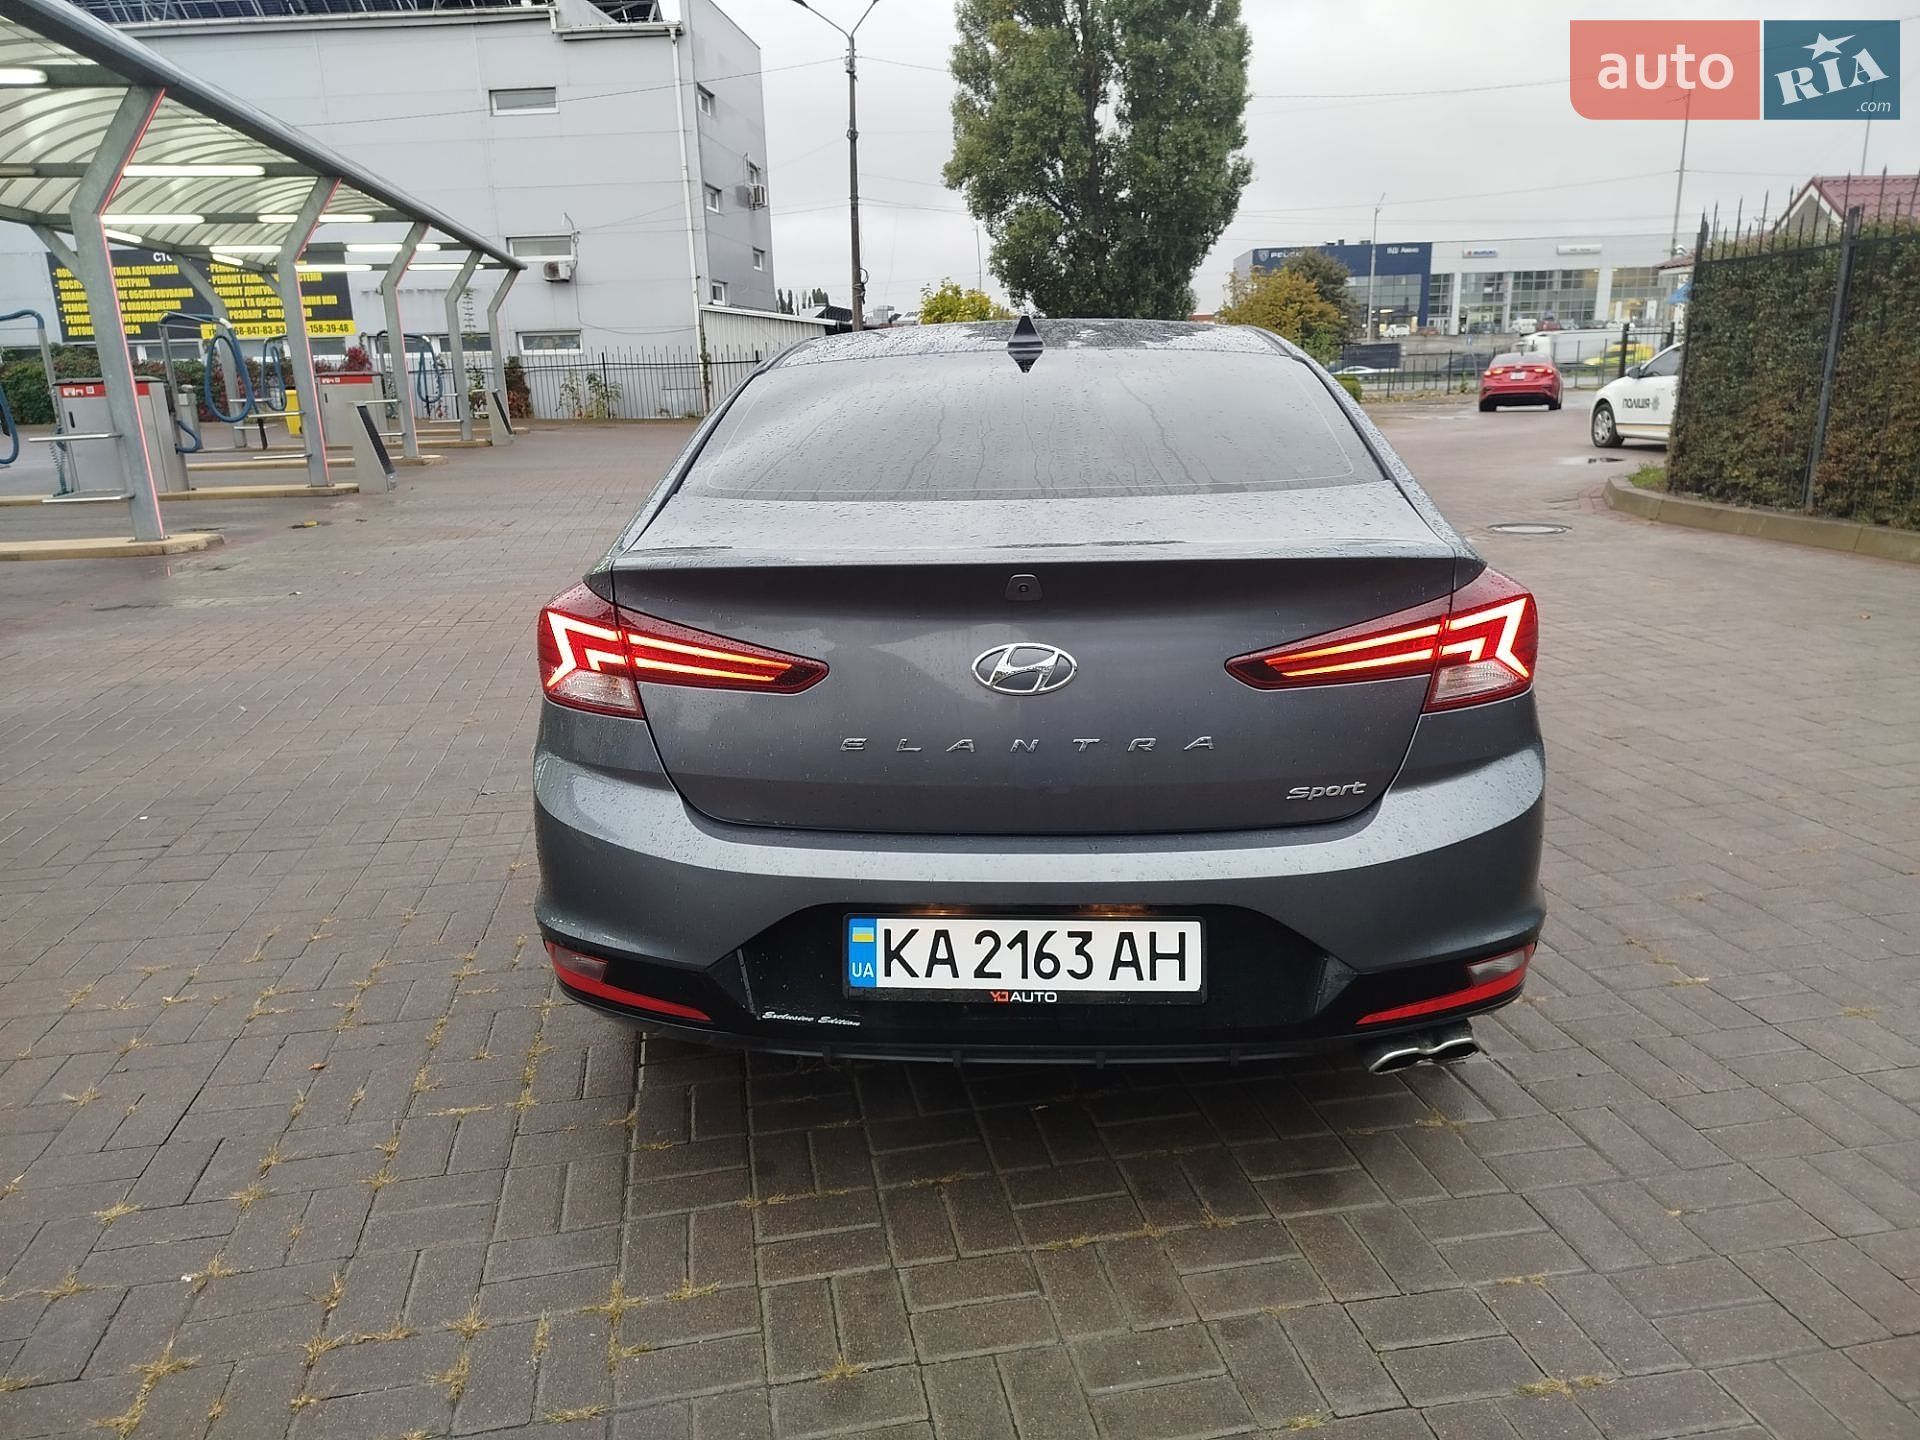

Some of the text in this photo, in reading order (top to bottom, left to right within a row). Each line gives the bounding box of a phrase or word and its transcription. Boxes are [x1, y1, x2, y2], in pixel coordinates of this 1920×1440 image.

[840, 736, 1214, 752] ELANTRA
[1286, 781, 1367, 800] Sport
[884, 929, 1186, 981] KA 2163 AH
[852, 962, 874, 977] UA
